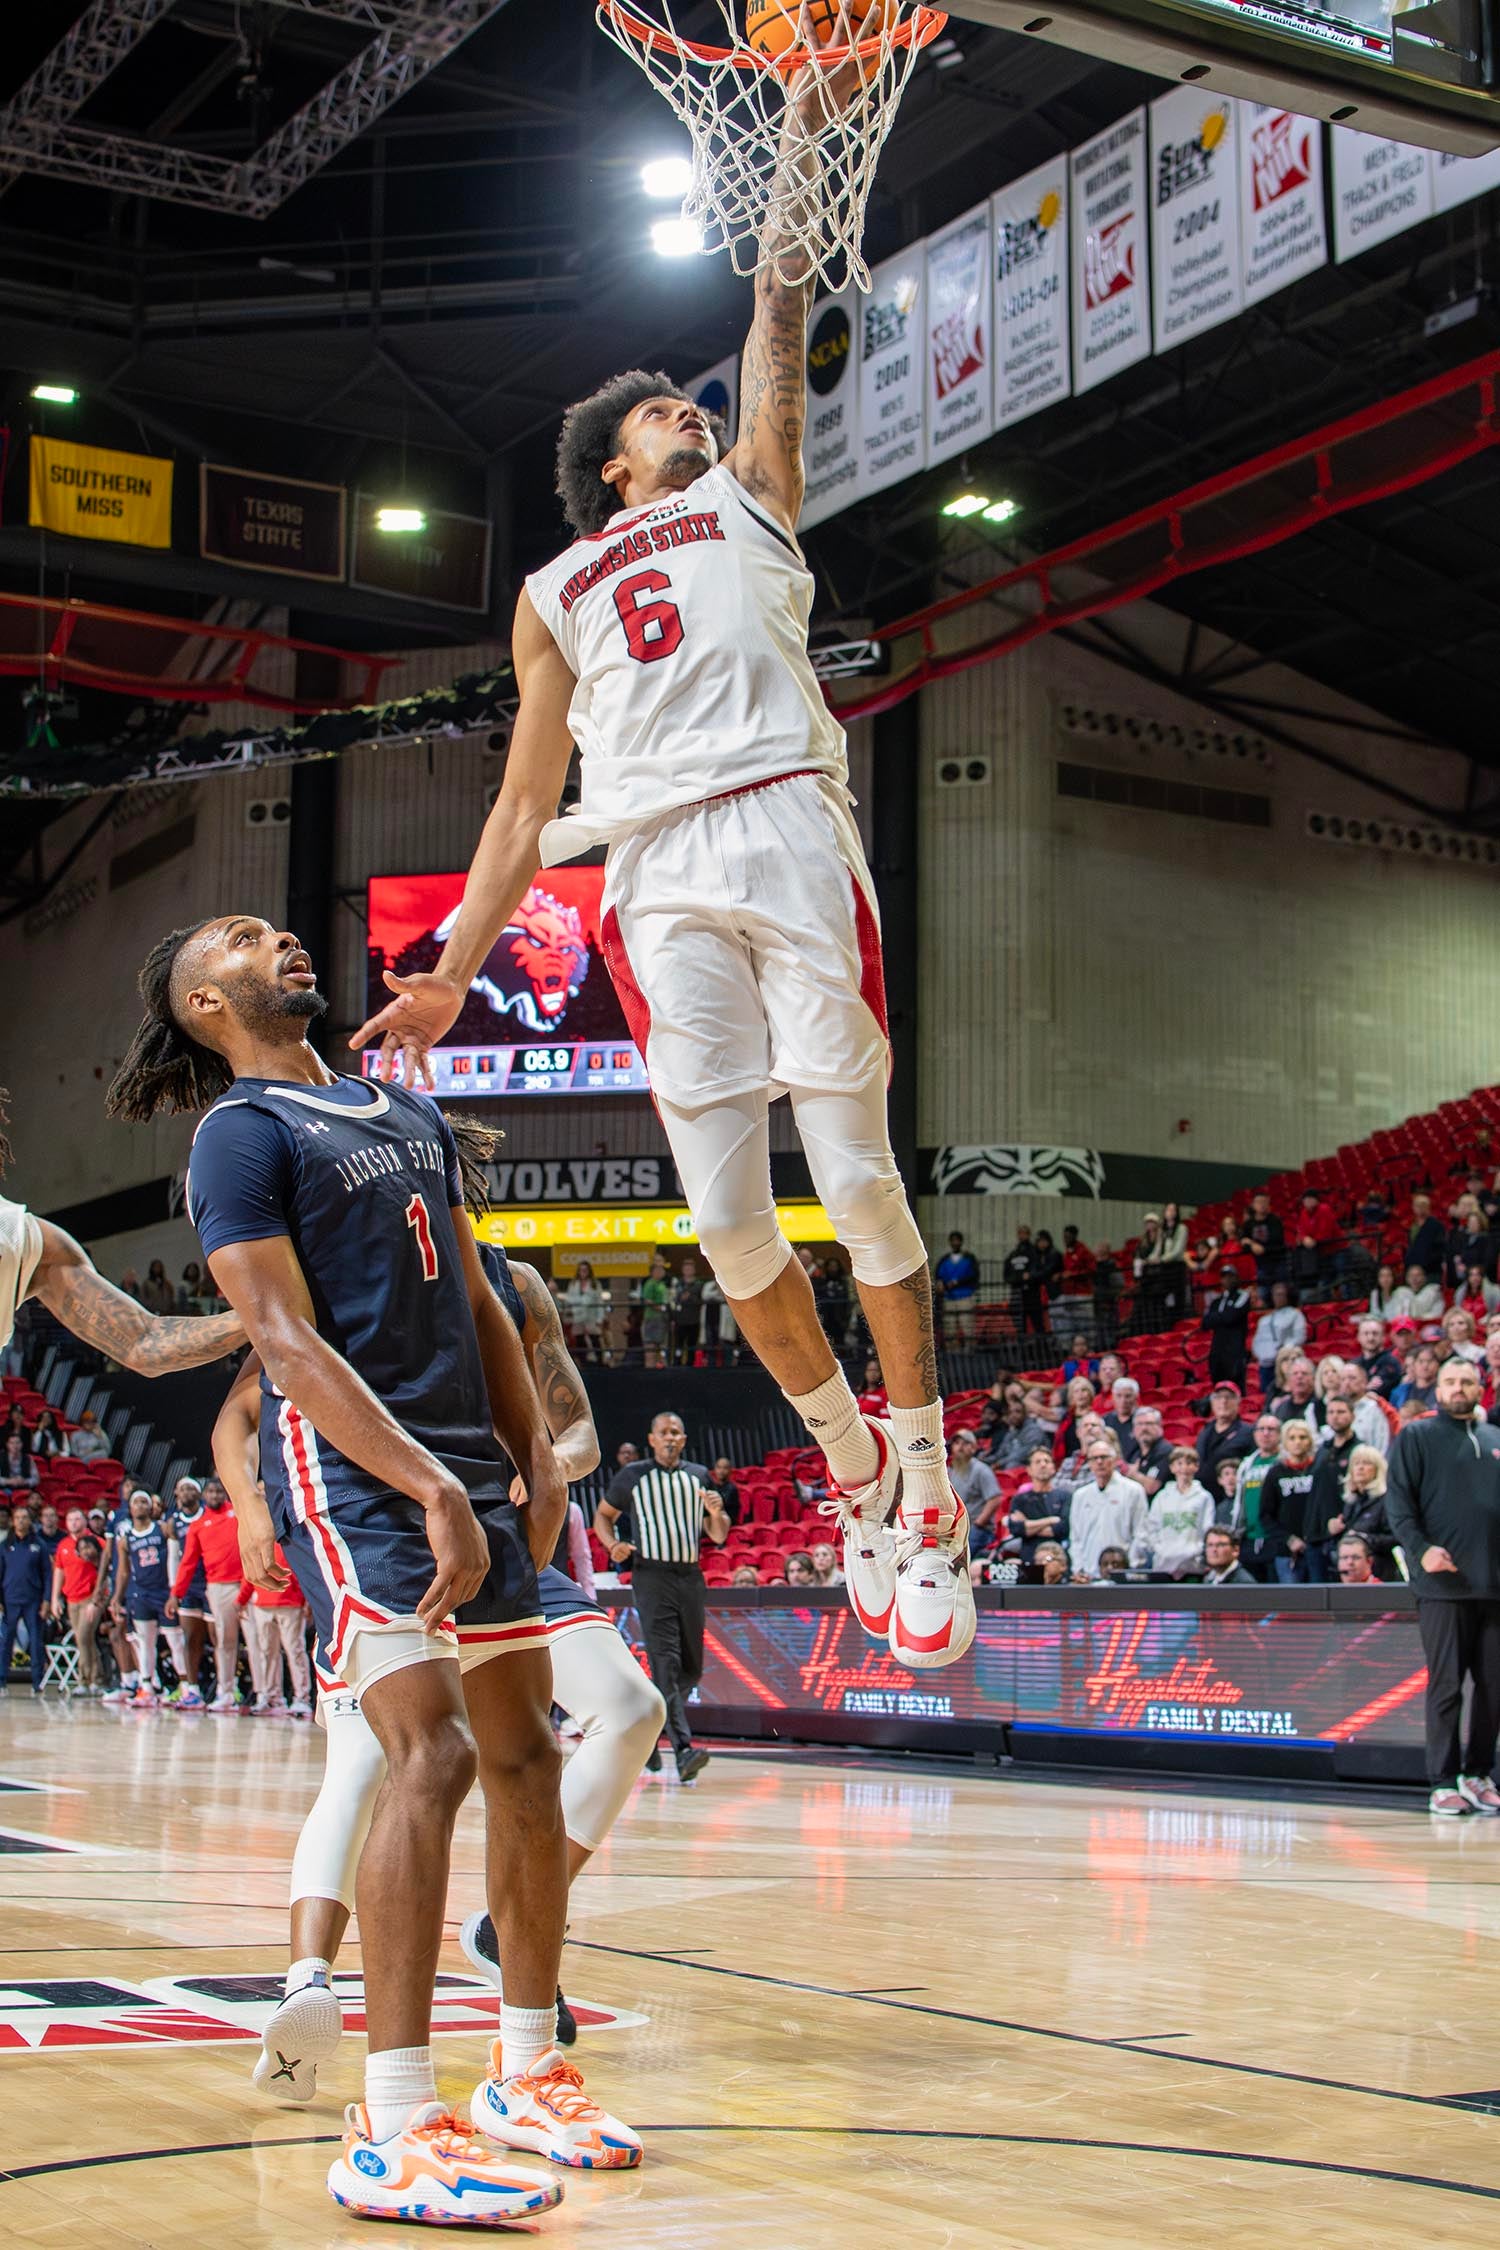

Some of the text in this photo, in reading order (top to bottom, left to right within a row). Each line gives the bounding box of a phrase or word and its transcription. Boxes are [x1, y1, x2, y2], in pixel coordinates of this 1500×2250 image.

[1159, 135, 1204, 168] SUN
[1157, 152, 1214, 208] BELT
[1174, 201, 1219, 244] 2004
[809, 332, 849, 368] NCAA
[50, 465, 152, 497] SOUTHERN
[76, 494, 124, 518] MISS
[245, 498, 304, 525] TEXAS
[242, 522, 302, 549] STATE
[559, 511, 726, 614] ARKANSAS STATE
[612, 568, 685, 664] 6
[453, 1057, 471, 1075] 10
[524, 1049, 570, 1072] 05.9
[590, 1052, 602, 1070] 0
[613, 1052, 632, 1069] 10
[335, 1140, 446, 1192] JACKSON STATE
[405, 1193, 439, 1282] 1
[566, 1216, 643, 1239] EXIT
[560, 1251, 649, 1265] CONCESSIONS
[908, 1442, 936, 1452] adidas
[845, 1691, 955, 1718] FAMILY DENTAL
[1147, 1706, 1298, 1736] FAMILY DENTAL
